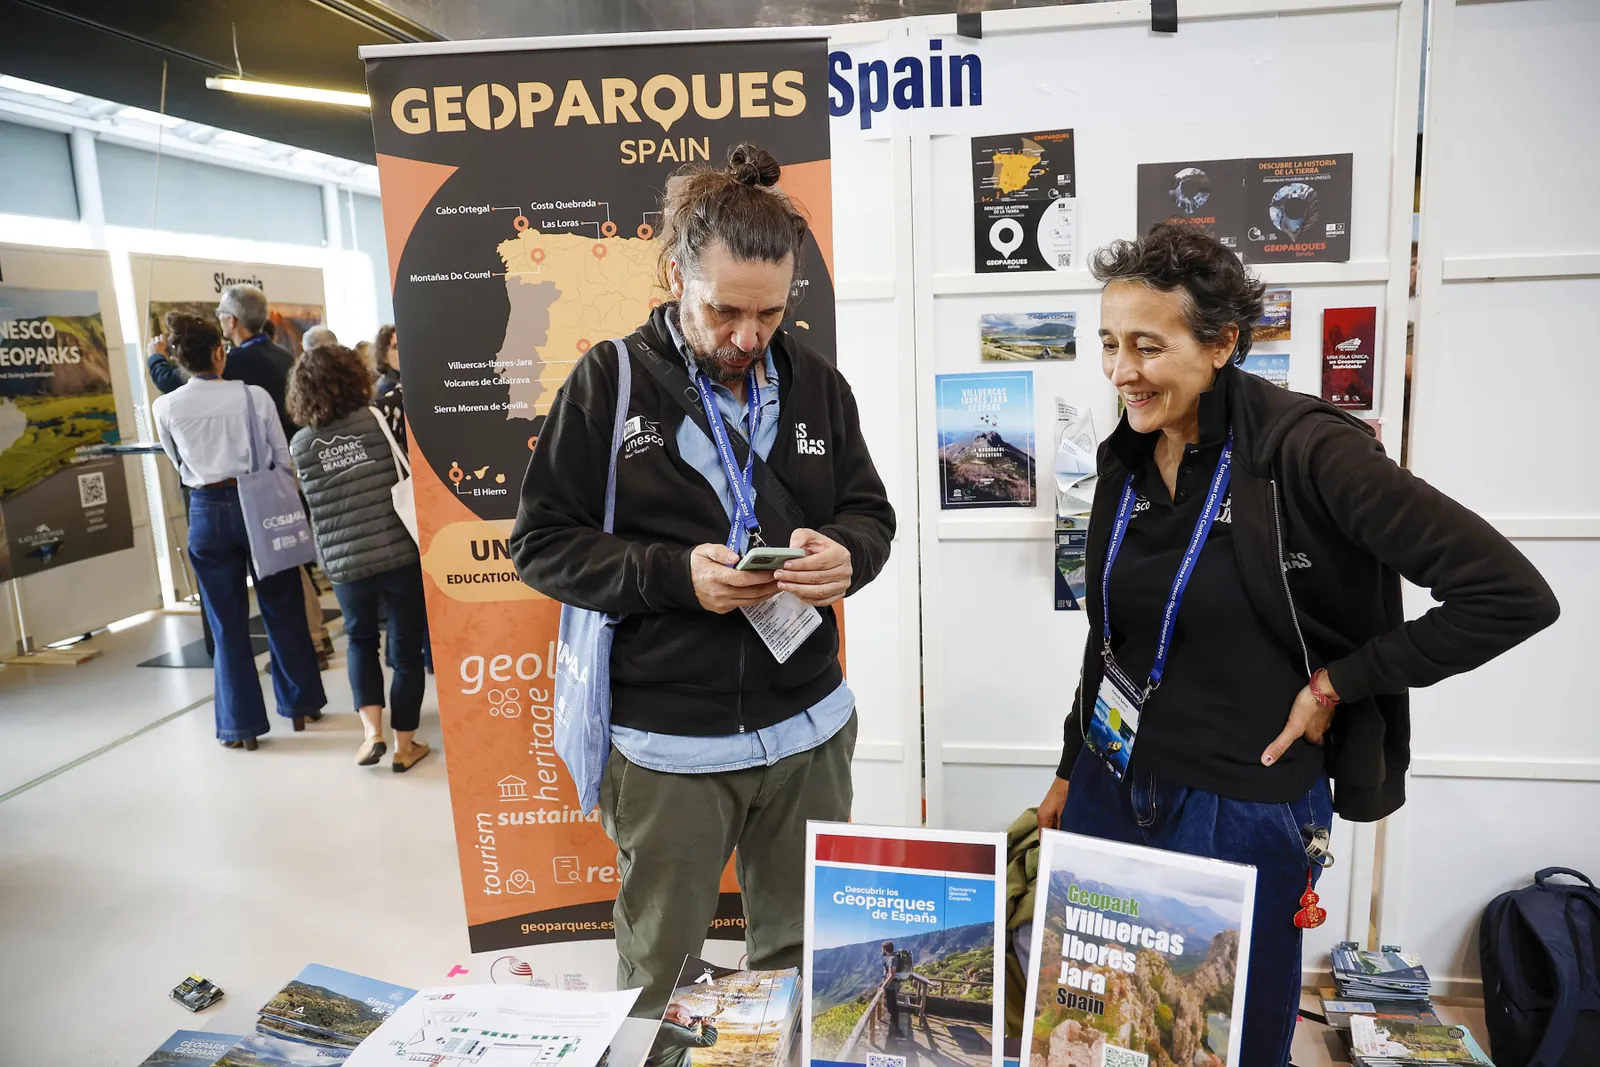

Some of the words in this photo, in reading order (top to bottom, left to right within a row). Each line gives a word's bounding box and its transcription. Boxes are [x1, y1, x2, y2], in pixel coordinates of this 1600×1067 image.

[827, 39, 982, 131] Spain
[391, 70, 807, 135] GEOPARQUES
[620, 136, 710, 165] SPAIN
[1259, 162, 1293, 170] DESCUBRE
[1304, 159, 1337, 167] HISTORIA
[436, 206, 457, 215] Cabo
[458, 204, 490, 215] Ortegal
[531, 202, 555, 210] Costa
[555, 199, 596, 210] Quebrada
[541, 220, 556, 229] Las
[557, 219, 579, 228] Loras
[1263, 242, 1327, 253] GEOPARQUES
[410, 272, 450, 283] Montañas
[451, 272, 463, 280] Do
[464, 270, 491, 280] Courel
[448, 358, 533, 370] Villuercas-Ibores-Jara
[444, 378, 479, 388] Volcanes
[480, 377, 492, 386] de
[493, 375, 530, 386] Calatrava
[434, 404, 457, 414] Sierra
[457, 403, 489, 412] Morena
[490, 401, 502, 411] de
[502, 400, 528, 411] Sevilla
[318, 440, 363, 460] GÉOPARC
[625, 434, 665, 453] unesco
[720, 443, 731, 465] Unesco
[727, 463, 737, 480] Global
[733, 479, 745, 503] Geopark
[1212, 463, 1228, 493] European
[473, 488, 482, 497] El
[482, 487, 507, 497] Hierro
[1202, 493, 1218, 519] Geopark
[731, 521, 740, 543] Geopark
[1179, 556, 1192, 578] Saimaa
[1171, 578, 1183, 601] Unesco
[1165, 600, 1176, 620] Global
[529, 687, 560, 802] heritage
[475, 813, 502, 896] tourism
[845, 886, 885, 895] Descubrir
[886, 888, 899, 896] los
[1067, 884, 1140, 918] Geopark
[833, 891, 936, 912] Geoparques
[872, 908, 888, 920] de
[891, 910, 937, 924] España
[521, 919, 614, 935] geoparques.es
[1065, 906, 1184, 957] Villuercas
[1061, 933, 1136, 974] Ibores
[1057, 964, 1106, 995] Jara
[364, 997, 394, 1009] Sierra
[371, 1006, 384, 1015] de
[1056, 987, 1104, 1015] Spain
[174, 1047, 222, 1057] GEOPARC
[180, 1040, 228, 1051] GEOPARK
